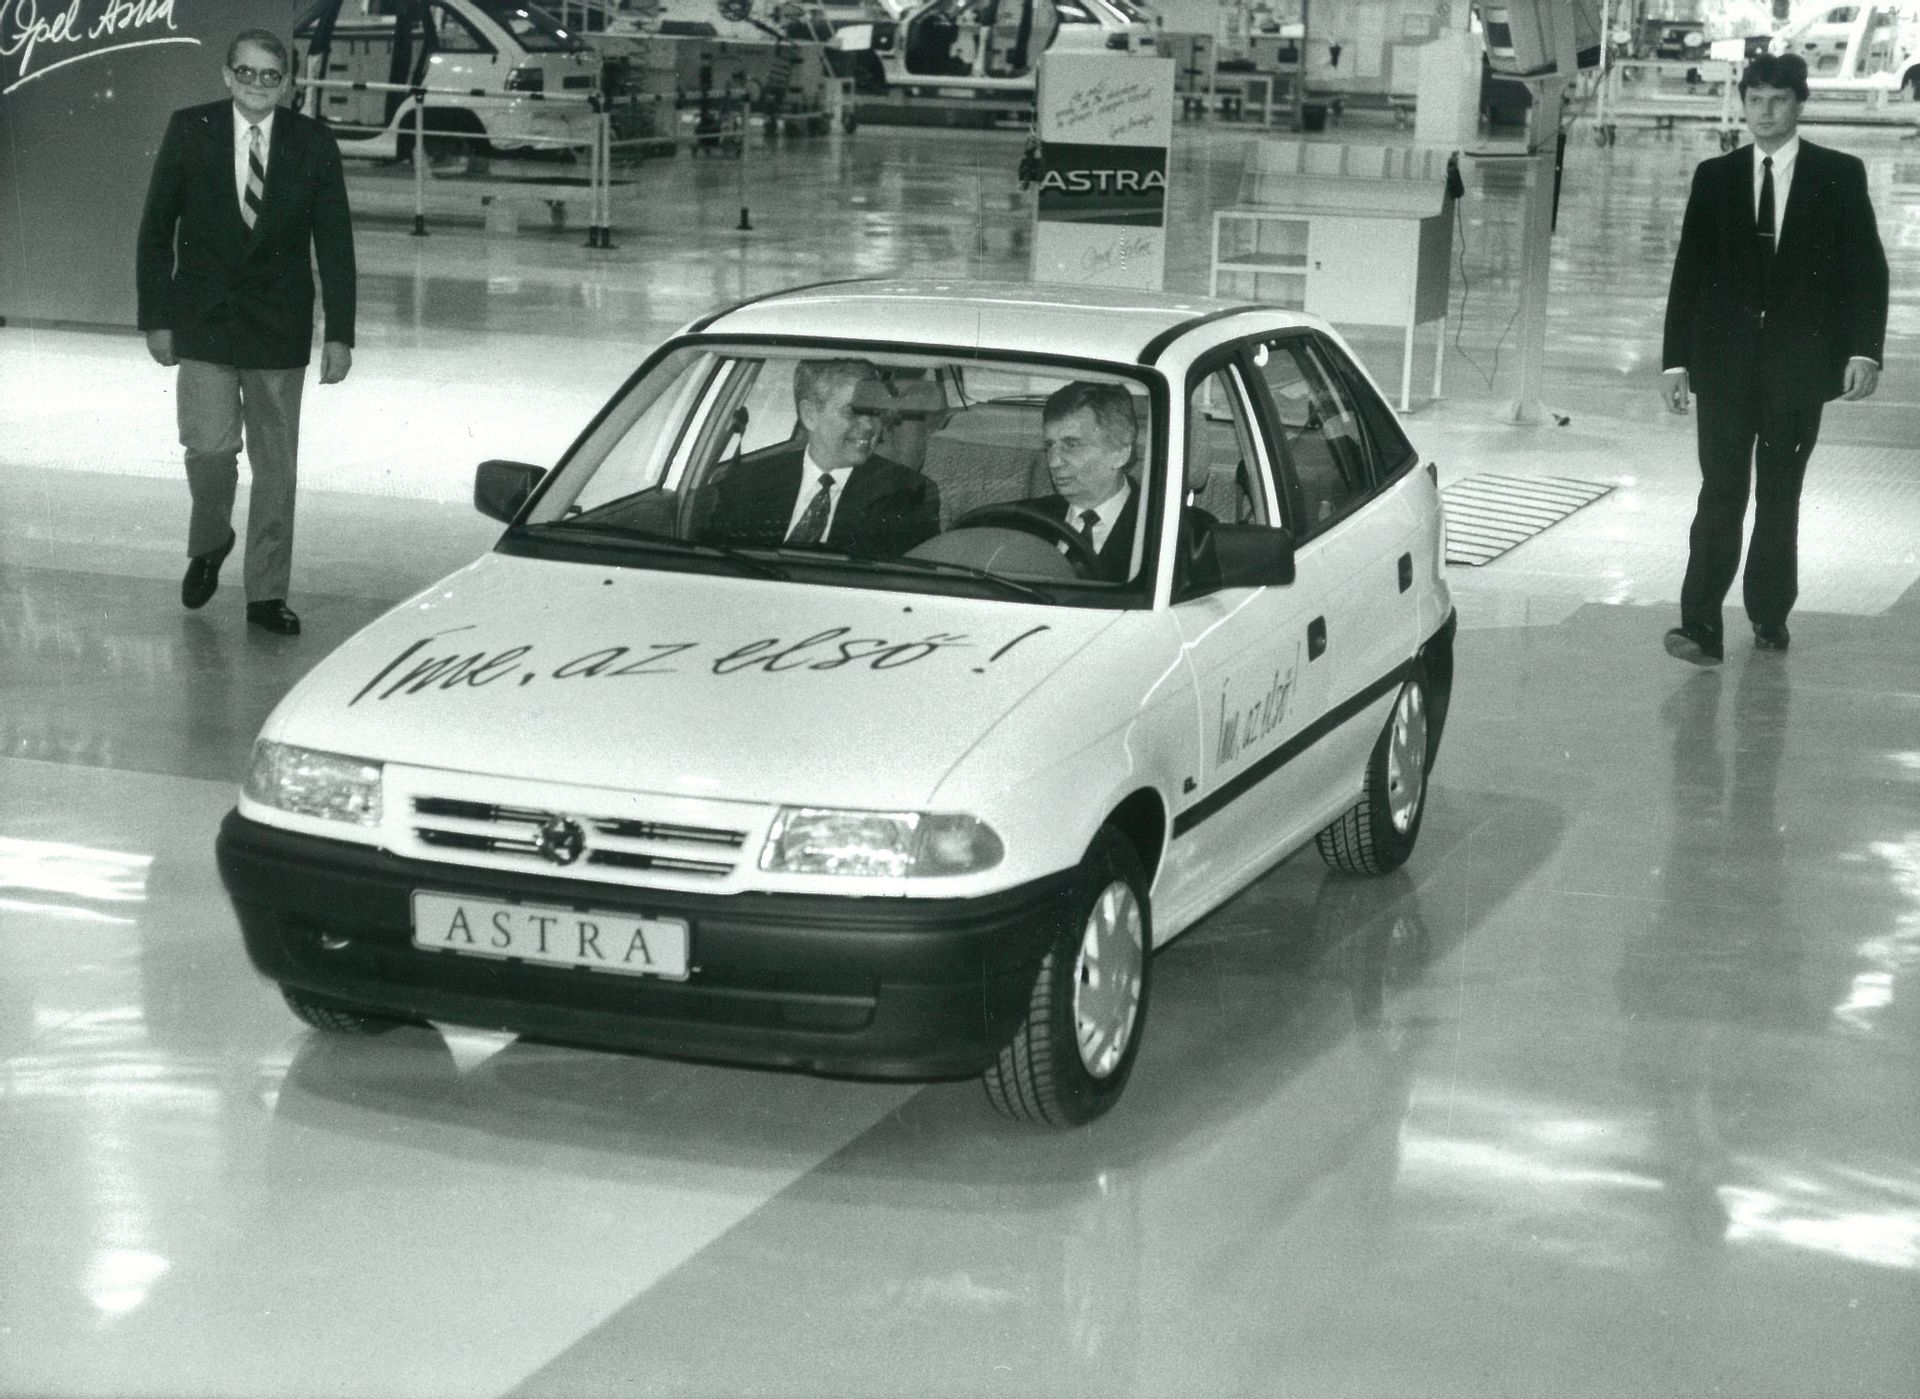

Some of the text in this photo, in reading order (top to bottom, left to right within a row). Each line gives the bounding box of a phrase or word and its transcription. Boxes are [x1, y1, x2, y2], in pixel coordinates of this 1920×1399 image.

[1039, 169, 1166, 191] ASTRA
[551, 643, 700, 679] az
[445, 906, 655, 965] ASTRA
